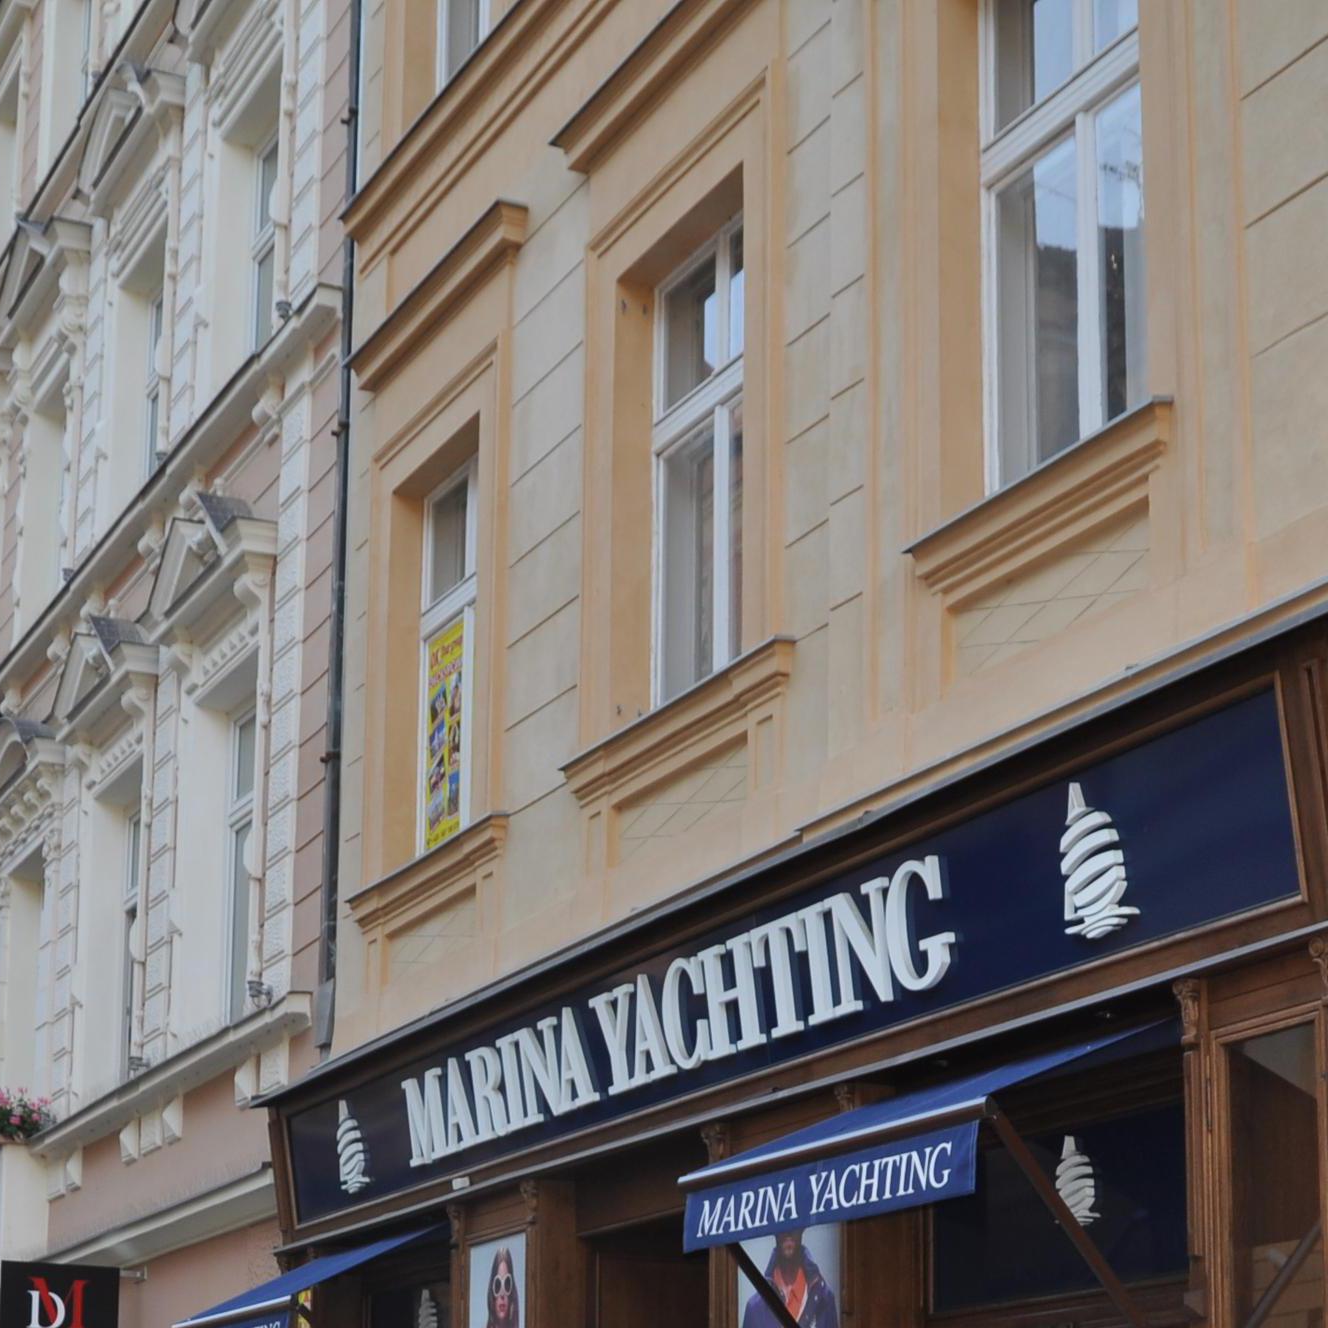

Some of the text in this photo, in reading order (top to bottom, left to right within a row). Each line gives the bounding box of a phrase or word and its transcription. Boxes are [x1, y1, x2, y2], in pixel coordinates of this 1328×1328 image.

[401, 855, 956, 1168] MARINA YACHTING
[696, 1141, 953, 1239] MARINA YACHTING
